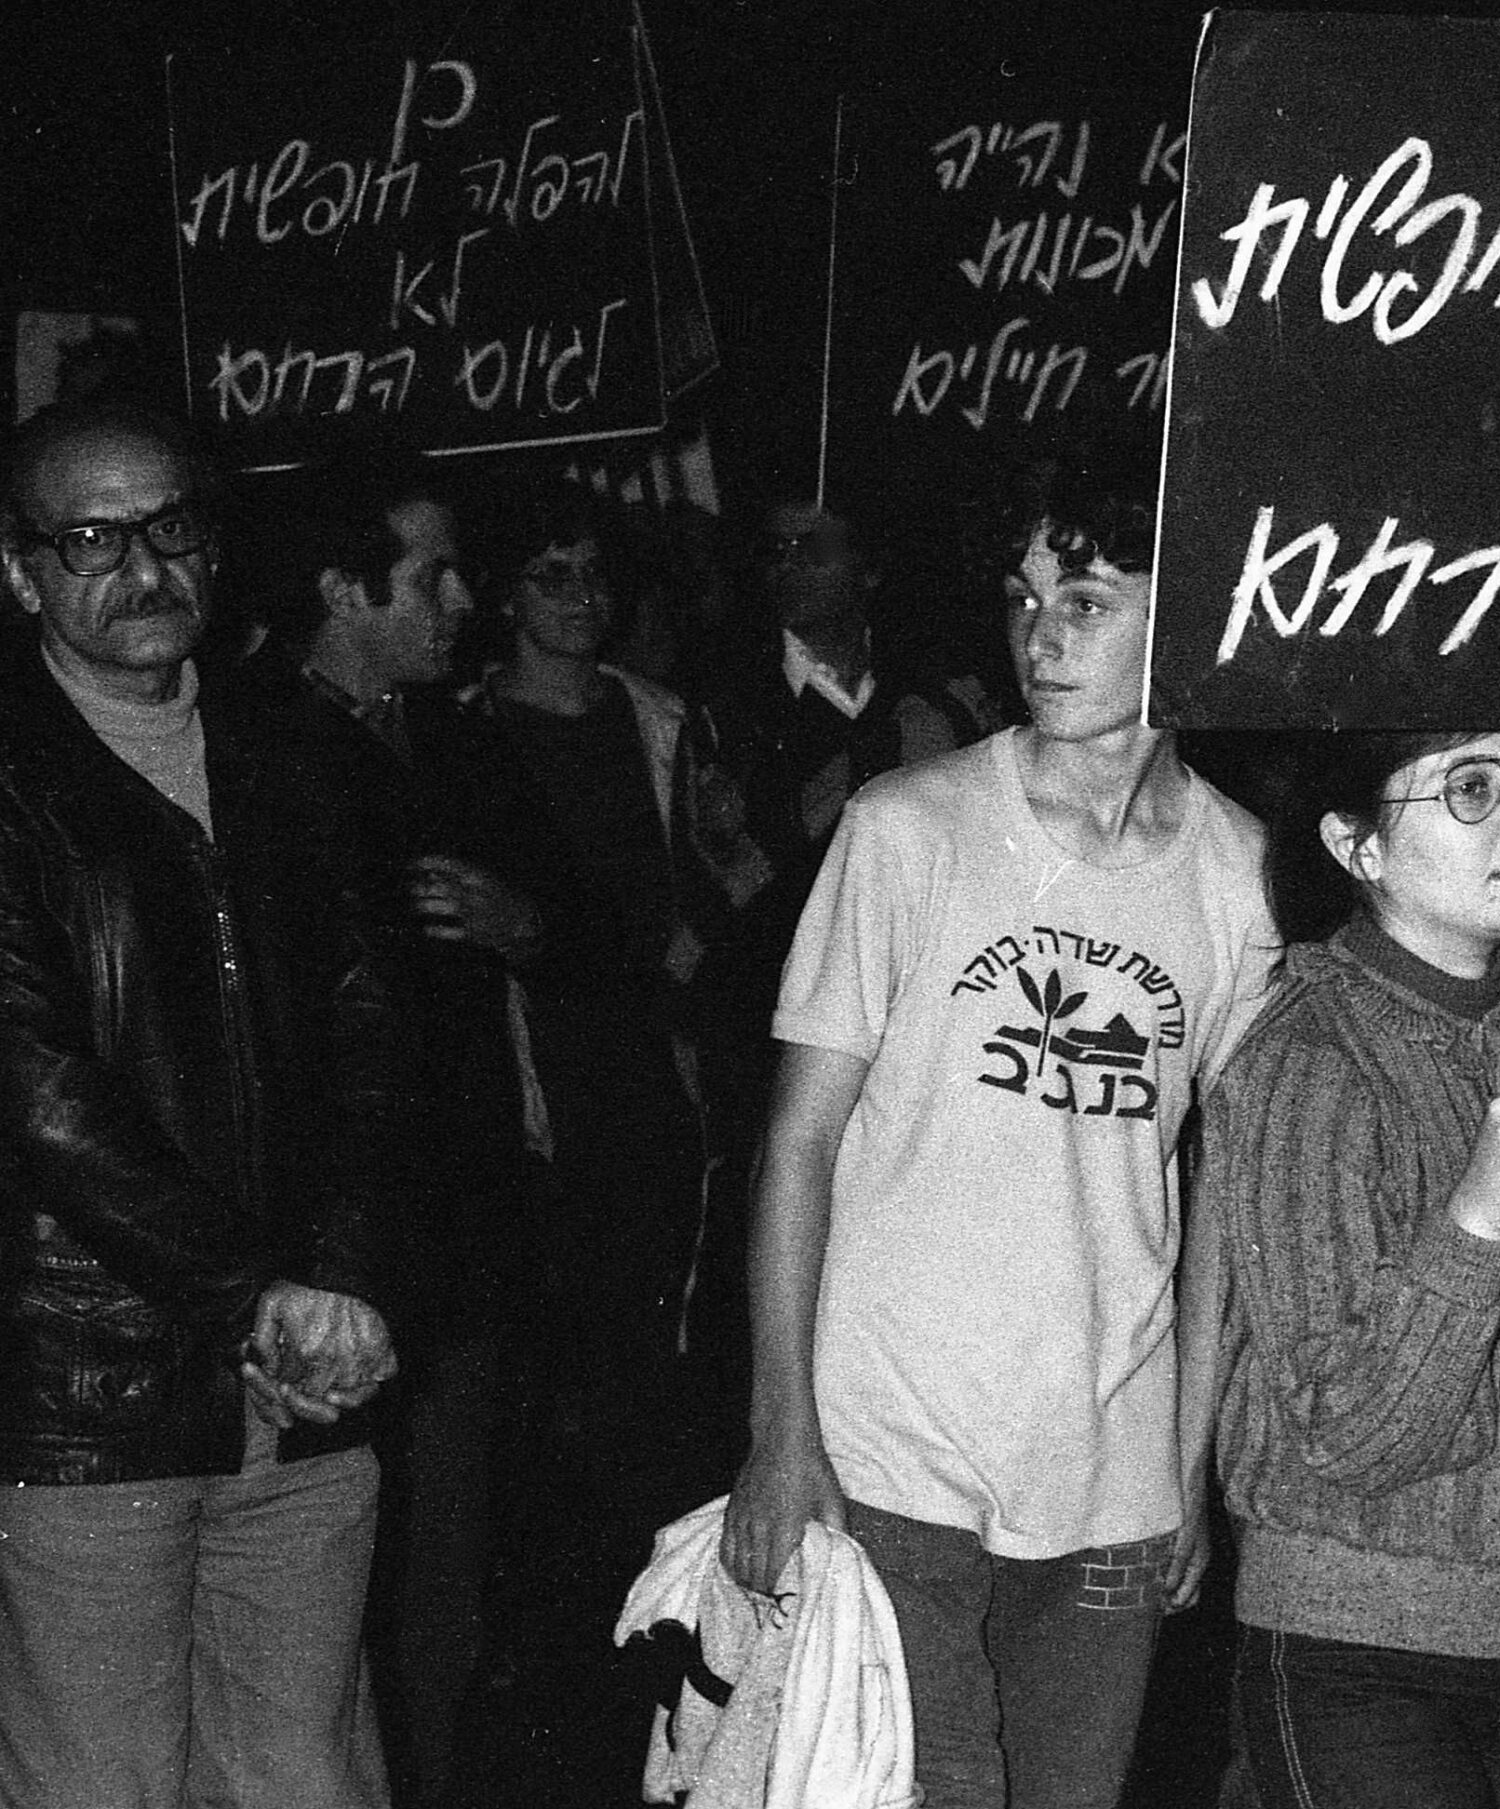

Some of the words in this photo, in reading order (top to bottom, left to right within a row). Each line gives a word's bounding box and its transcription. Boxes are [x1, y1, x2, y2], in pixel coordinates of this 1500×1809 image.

[388, 60, 476, 163] כן
[1140, 122, 1187, 186] א
[178, 139, 419, 247] חופשית
[461, 106, 645, 224] להפלה
[391, 229, 487, 328] לא
[958, 200, 1177, 295] מכונות
[209, 343, 416, 421] הרחם
[455, 299, 626, 413] לגיוס
[892, 317, 1088, 430] חיילים
[1116, 951, 1186, 1050] מדרשת
[977, 1042, 1160, 1121] בנגב
